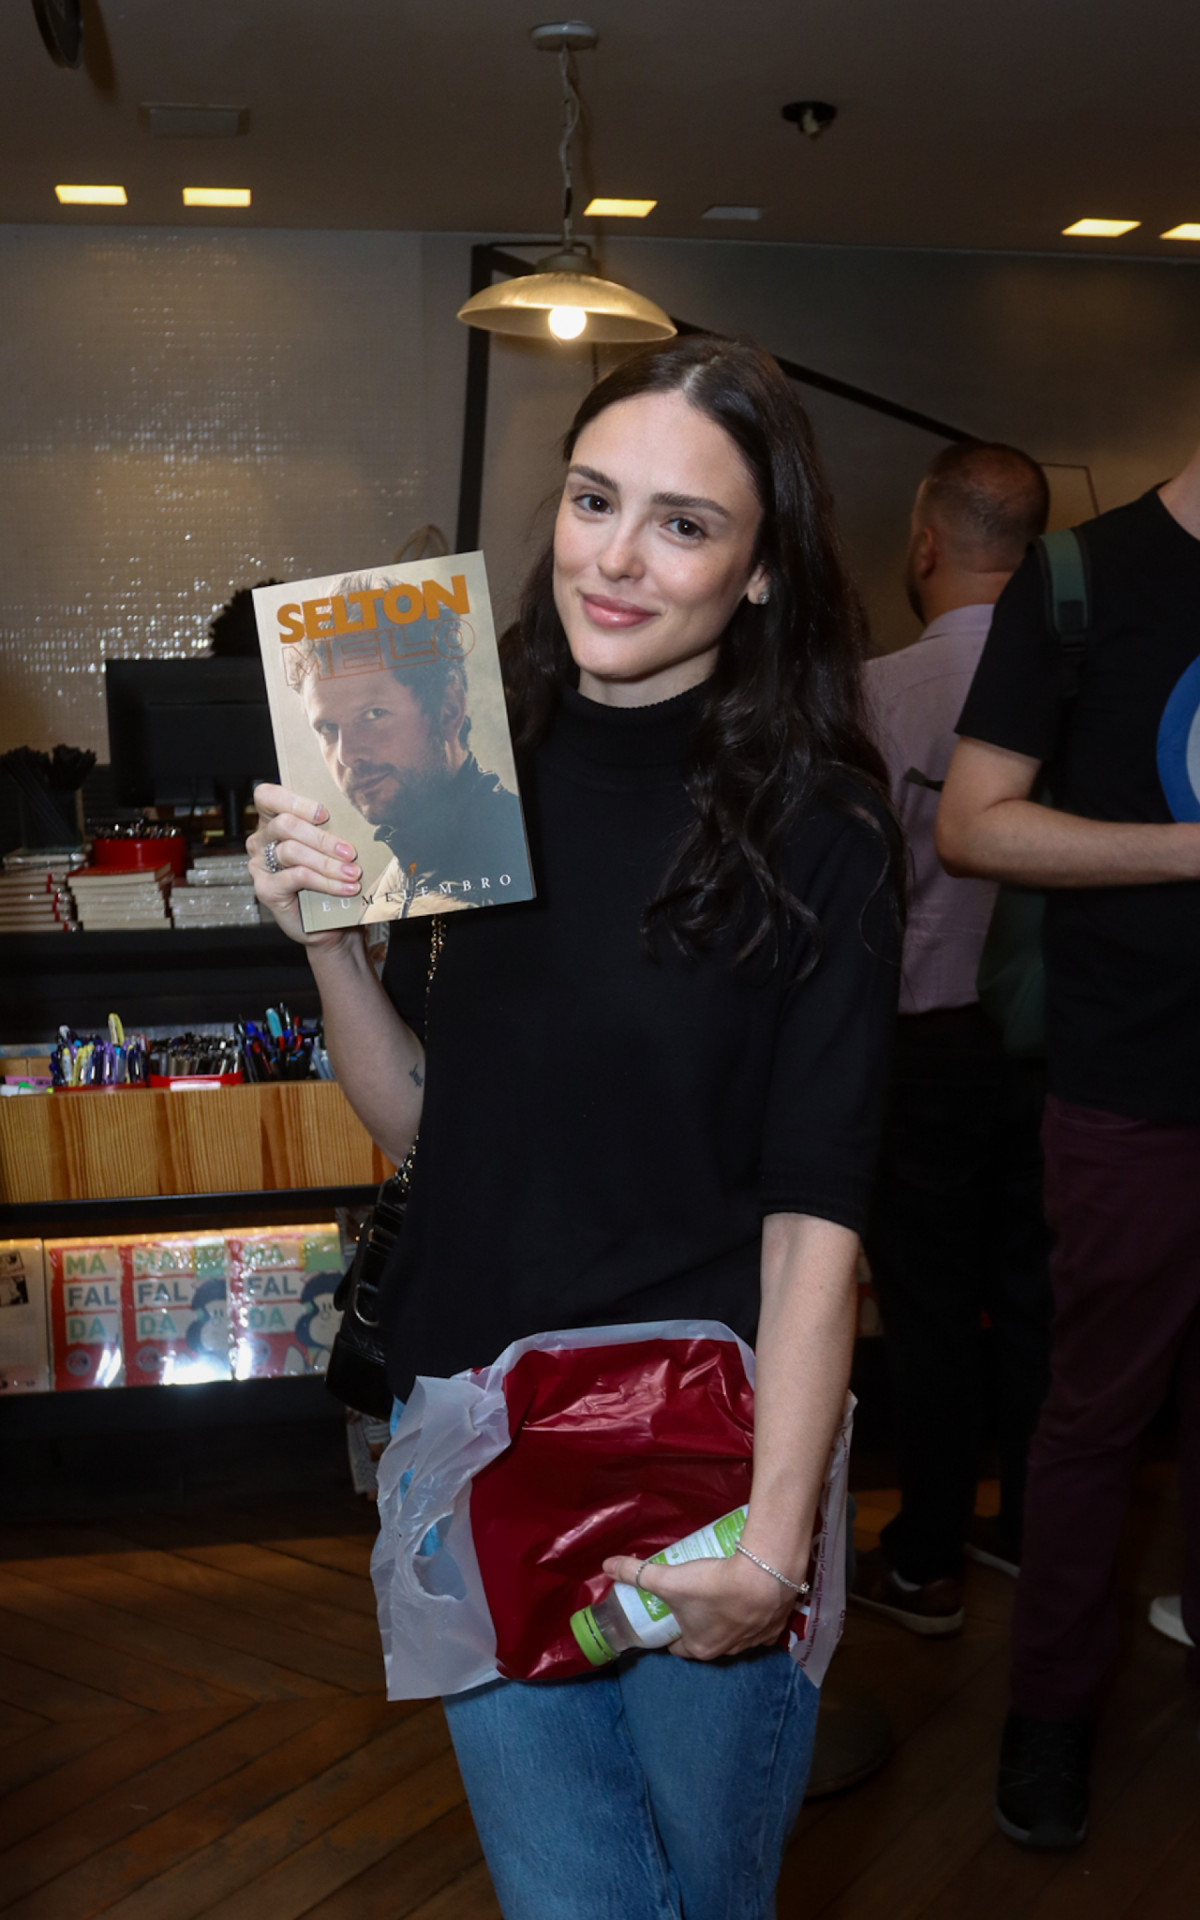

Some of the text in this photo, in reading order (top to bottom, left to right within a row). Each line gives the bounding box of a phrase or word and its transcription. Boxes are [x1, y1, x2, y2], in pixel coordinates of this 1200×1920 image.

[277, 574, 471, 644] SELTON
[281, 617, 476, 687] MELLO
[402, 874, 512, 900] LEMBRO
[66, 1254, 106, 1276] MA
[135, 1250, 176, 1272] MA
[68, 1285, 118, 1308] FAL
[137, 1282, 188, 1304] FAL
[247, 1275, 298, 1298] FAL
[69, 1317, 107, 1340] DA
[139, 1313, 177, 1336] DA
[249, 1306, 287, 1329] DA
